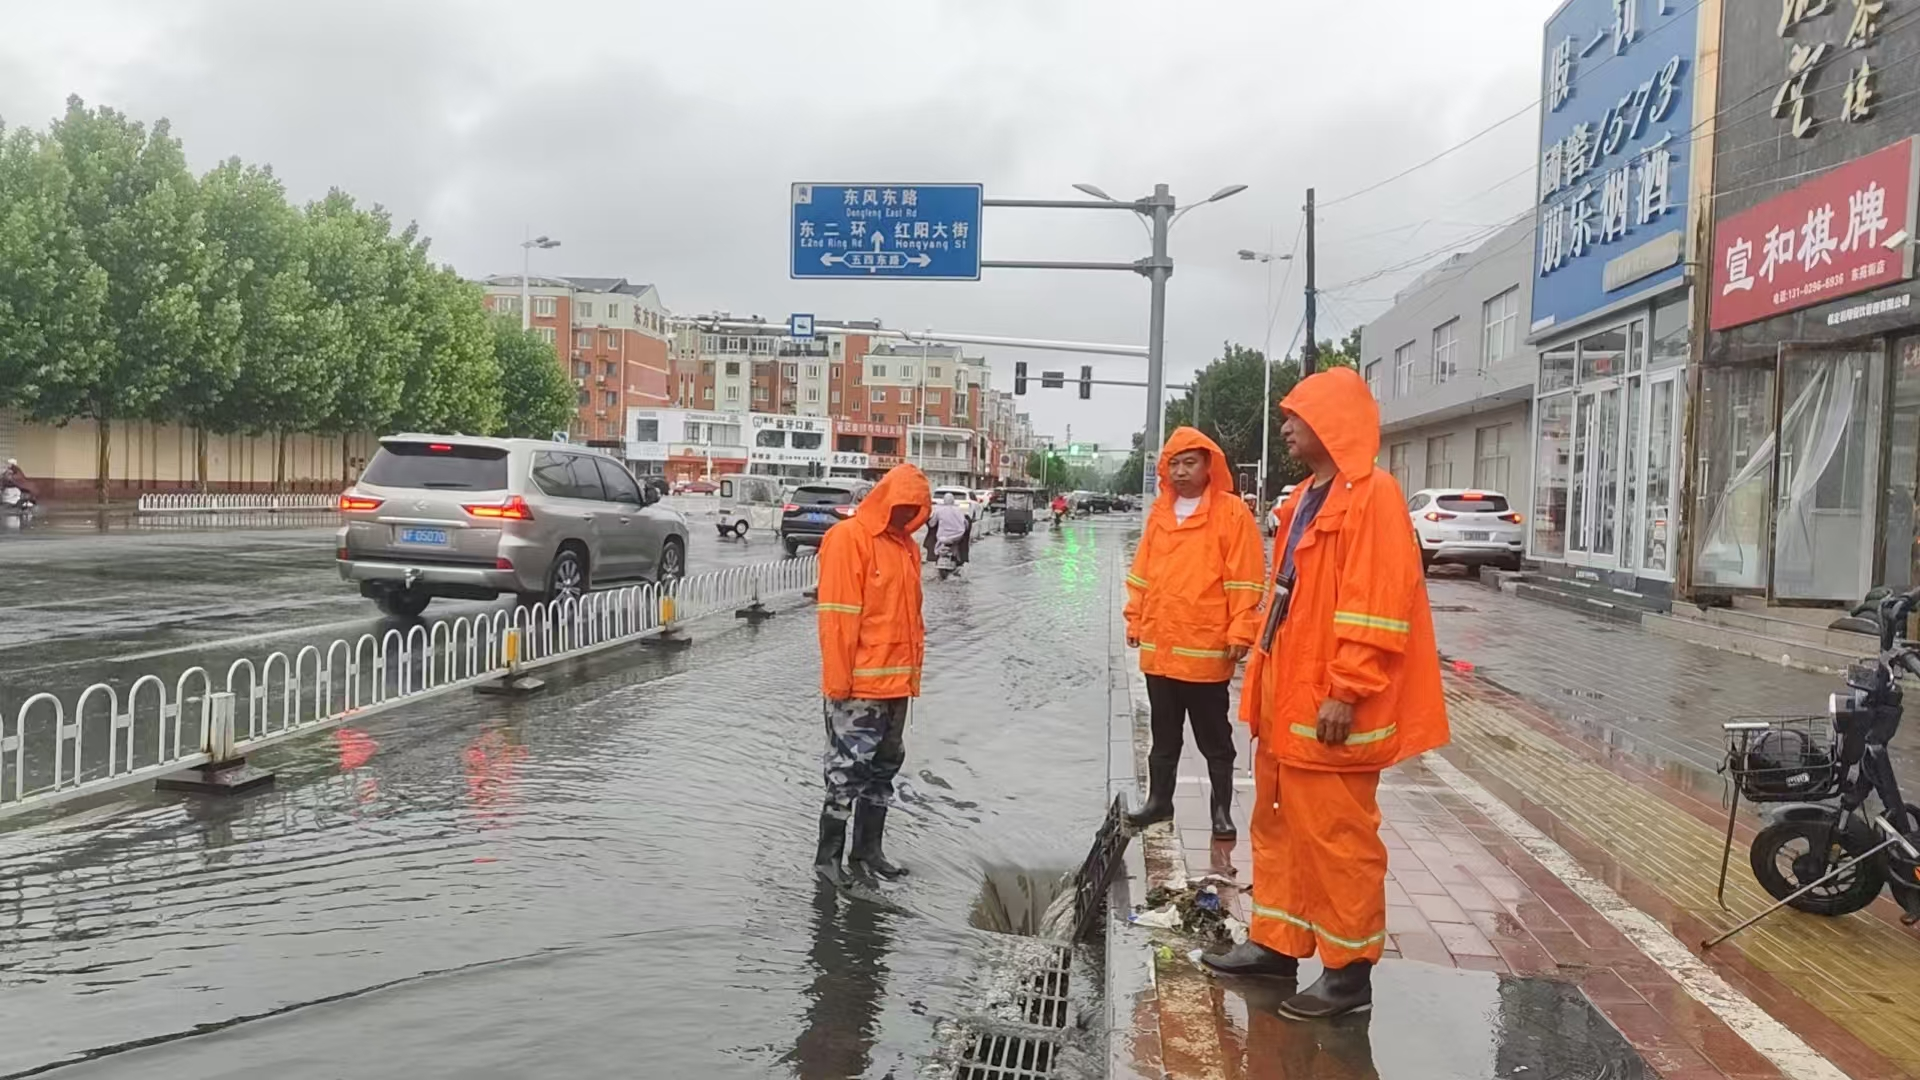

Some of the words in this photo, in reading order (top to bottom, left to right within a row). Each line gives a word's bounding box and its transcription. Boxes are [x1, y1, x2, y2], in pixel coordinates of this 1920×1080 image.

[843, 188, 918, 206] 东风东路
[846, 208, 881, 220] Dongfeng
[885, 208, 903, 218] East
[906, 208, 917, 217] Rd
[800, 221, 867, 237] 东二环
[894, 221, 969, 239] 红阳大街
[827, 238, 847, 249] Ring
[852, 239, 862, 248] Rd
[895, 239, 949, 251] Hongyang
[954, 239, 966, 249] St
[1723, 181, 1888, 296] 宣和棋牌
[851, 254, 900, 266] 五四东路
